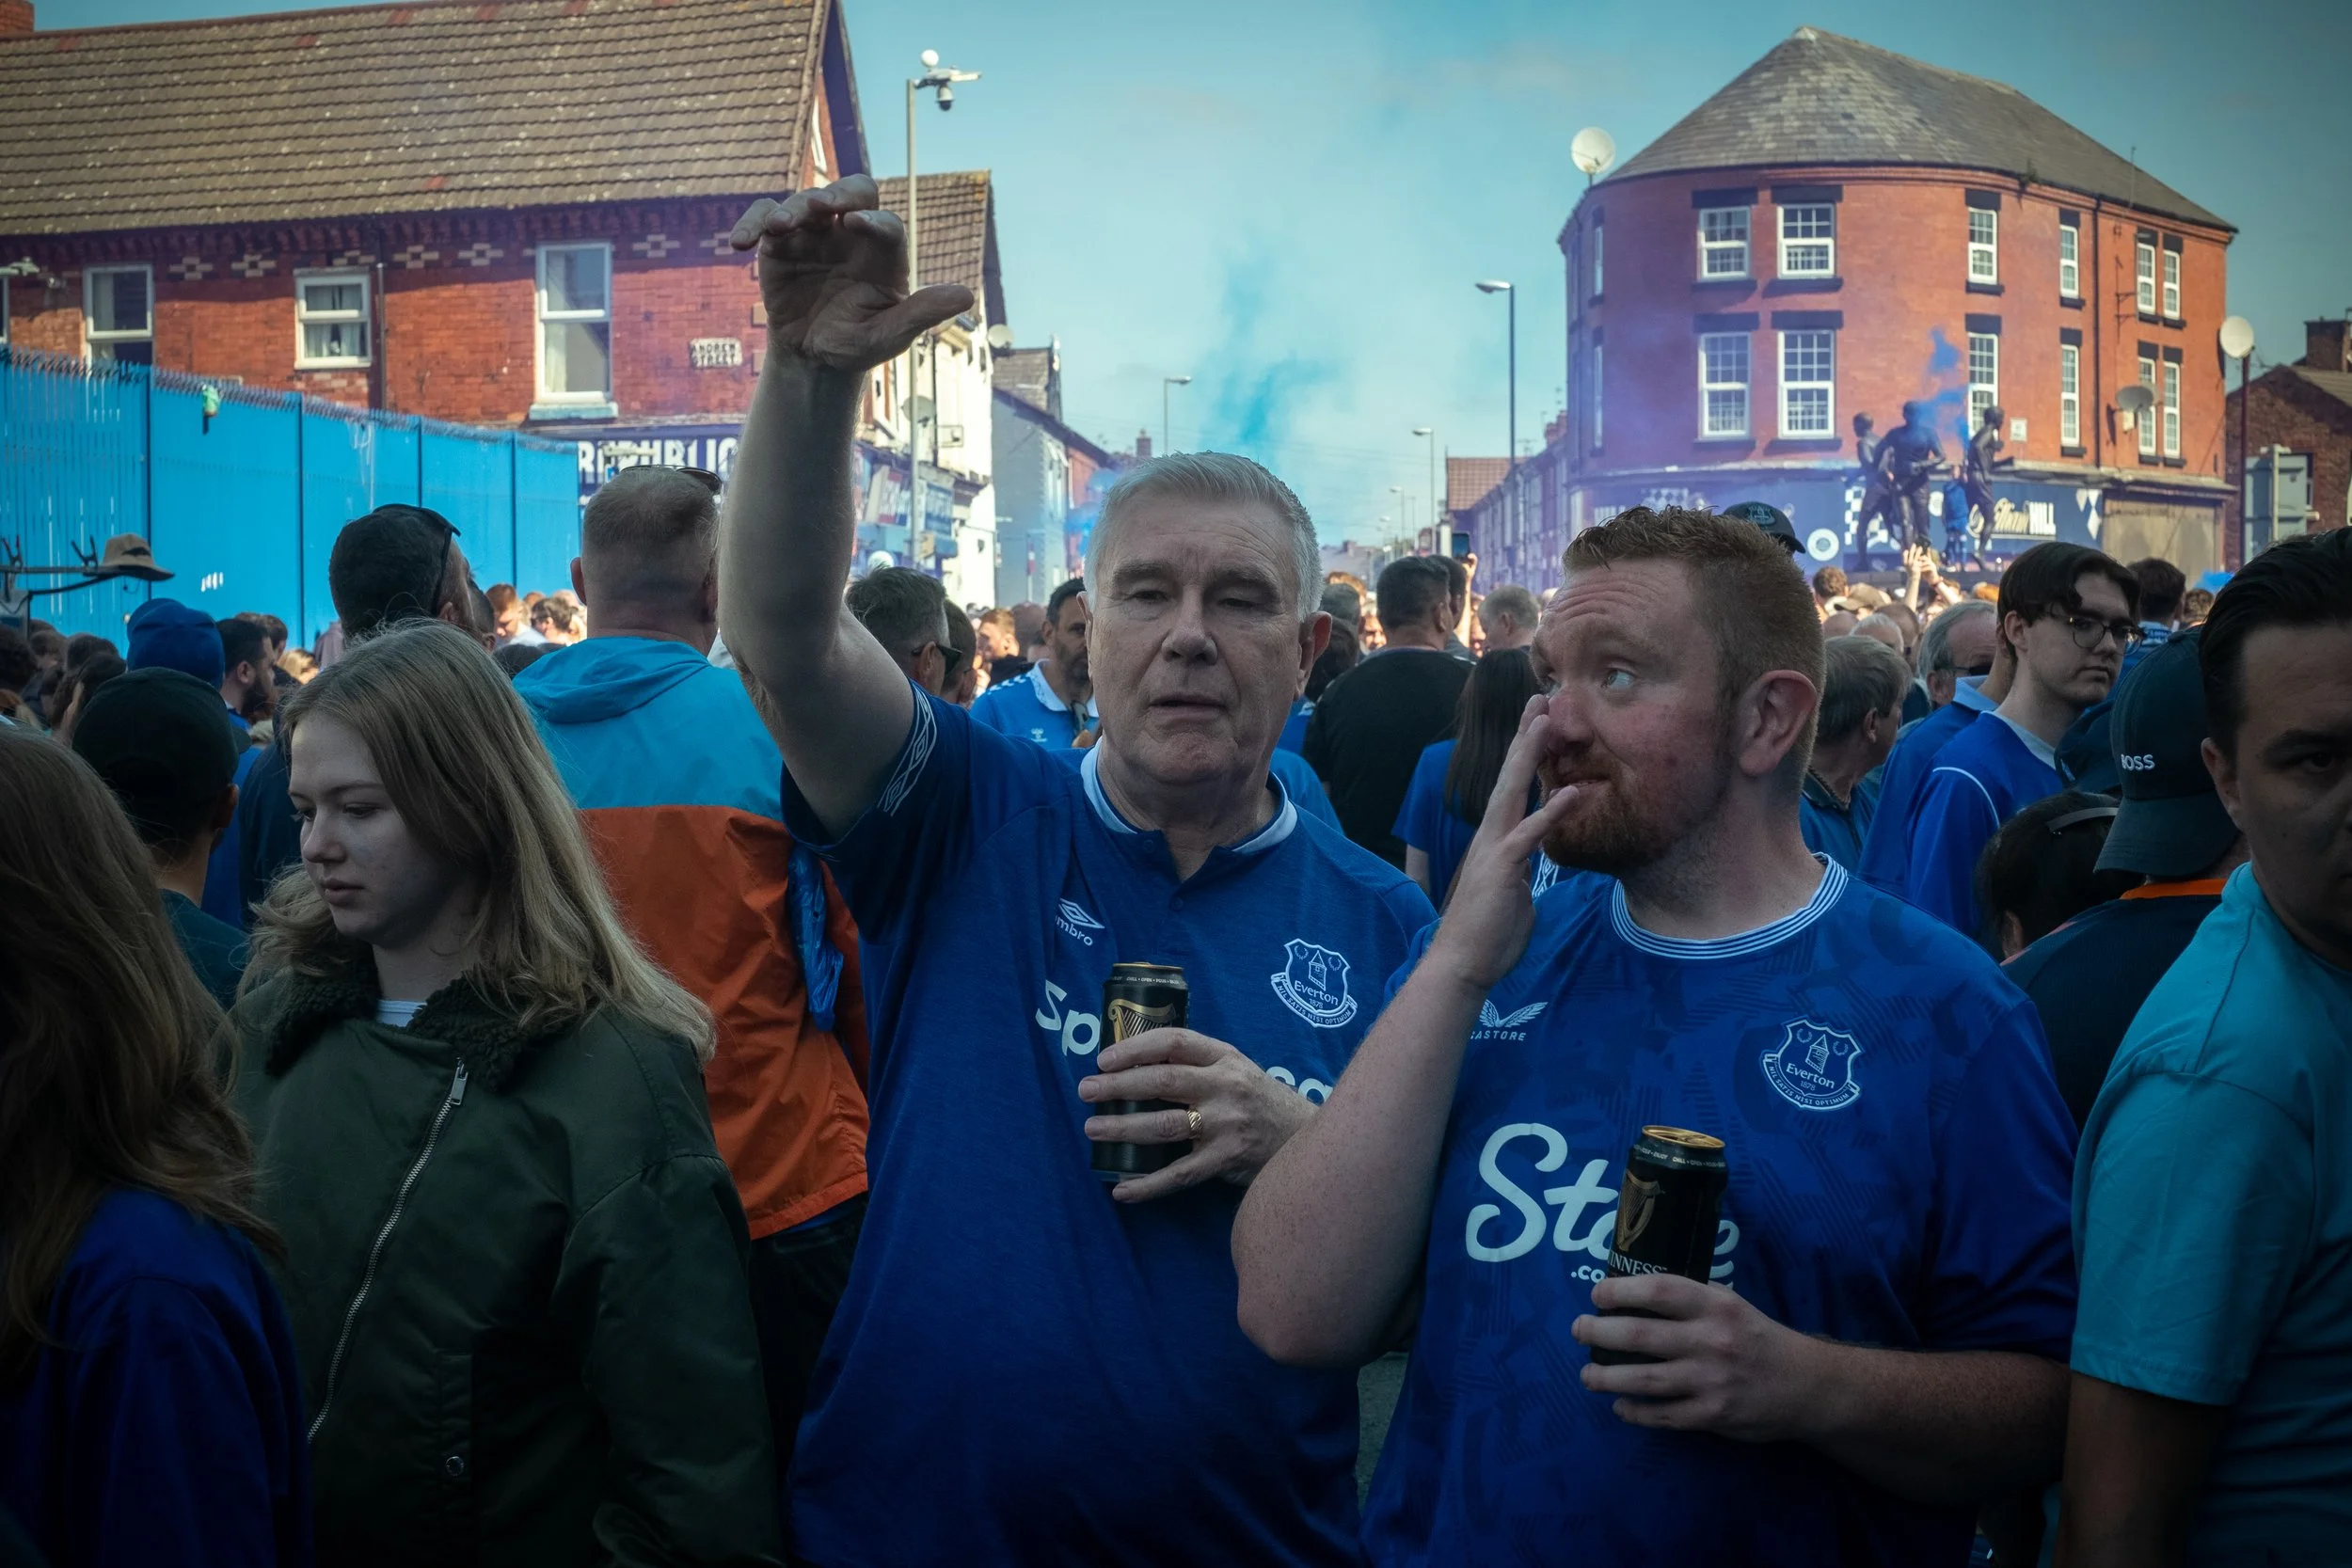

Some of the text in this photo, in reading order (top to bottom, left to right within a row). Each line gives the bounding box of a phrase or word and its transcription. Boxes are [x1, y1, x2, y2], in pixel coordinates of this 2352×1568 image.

[1055, 915, 1093, 946] mbro
[1277, 985, 1352, 1025] NIL SATIS NISI OPTIMUM
[1294, 979, 1339, 1006] Everton
[1309, 998, 1324, 1009] 1878
[1768, 1065, 1851, 1106] NIL SATIS NISI OPTIMUM
[1785, 1062, 1836, 1089] Everton
[1799, 1080, 1817, 1092] 1878
[1570, 1265, 1607, 1284] .co
